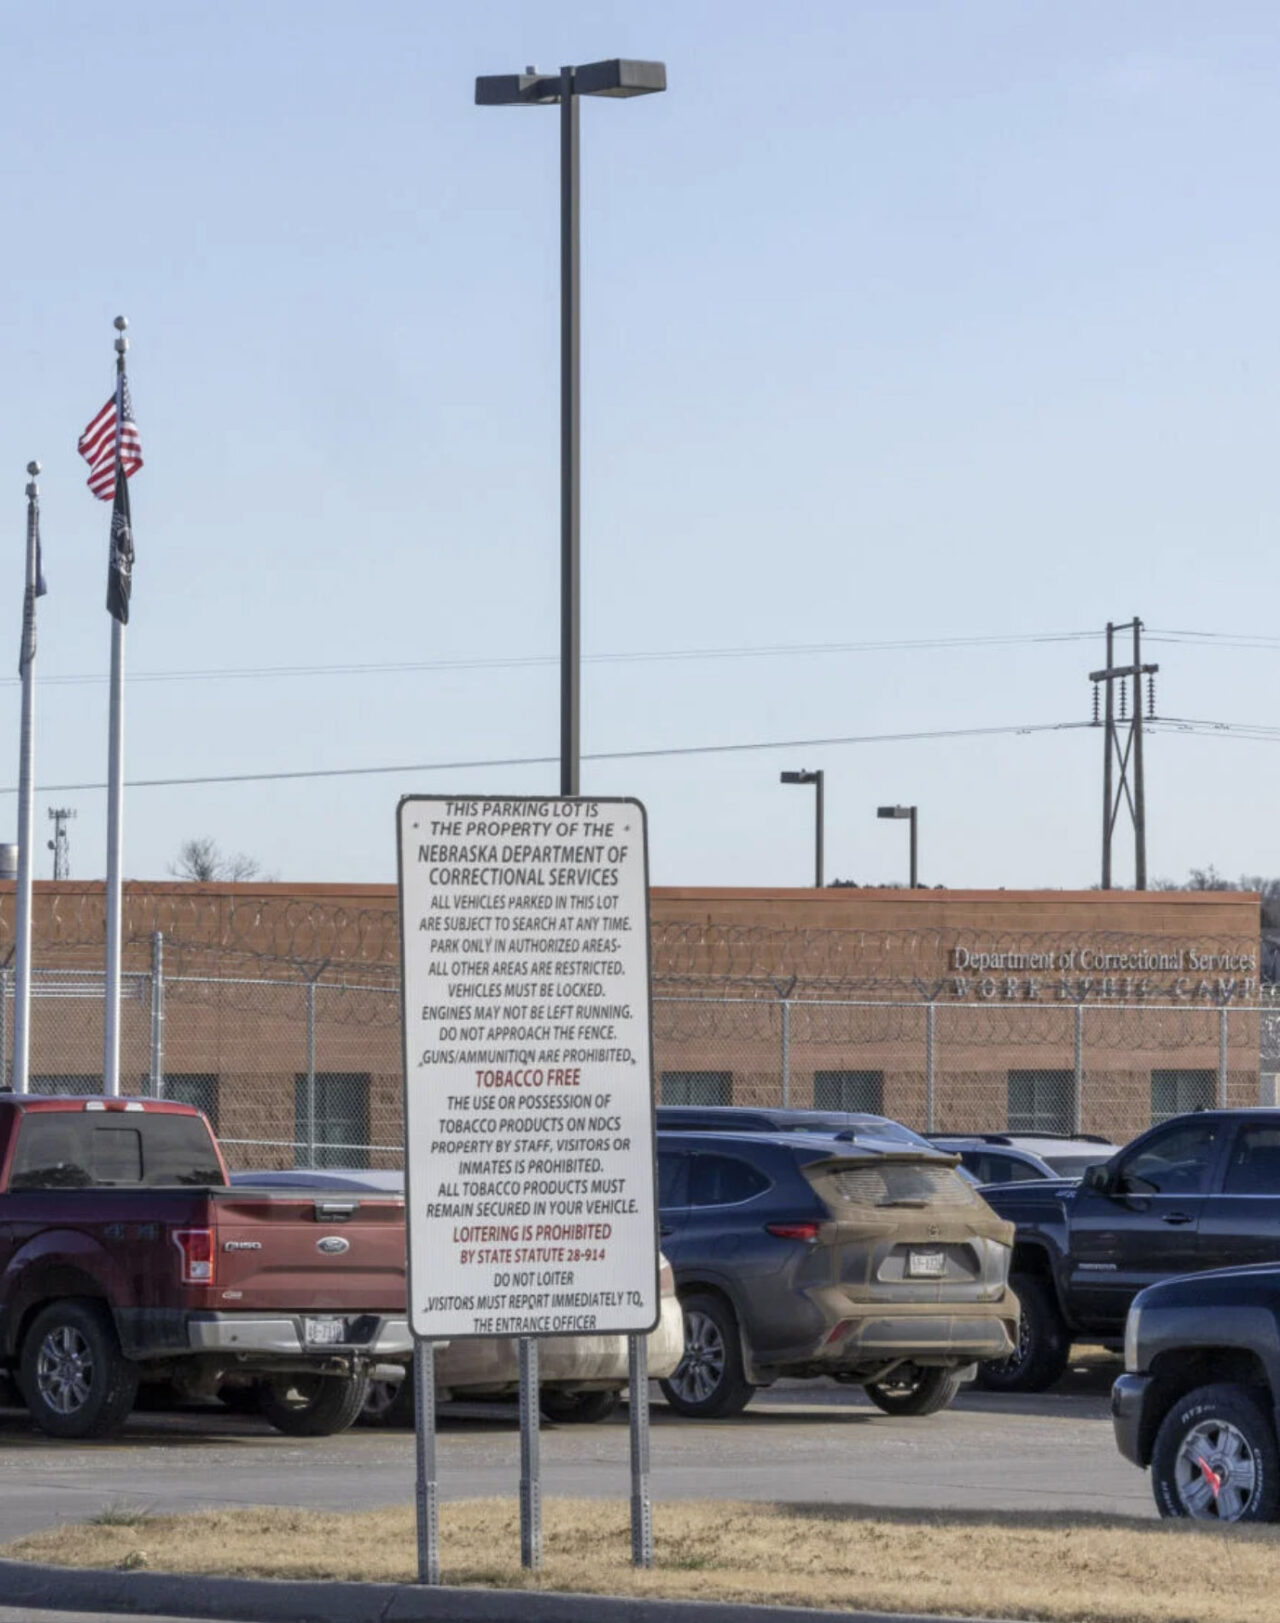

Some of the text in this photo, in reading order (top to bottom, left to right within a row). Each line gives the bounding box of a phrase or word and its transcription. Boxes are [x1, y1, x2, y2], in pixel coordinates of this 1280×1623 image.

[446, 802, 599, 817] THIS PARKING LOT IS
[431, 821, 614, 837] THE PROPERTY OF THE
[418, 845, 628, 863] NEBRASKA DEPARTMENT OF
[429, 868, 618, 886] CORRECTIONAL SERVICES
[431, 895, 619, 909] ALL VEHICLES PARKED IN THIS LOT
[419, 917, 632, 931] ARE SUBJECT TO SEARCH AT ANY TIME.
[431, 939, 459, 953] PARK
[462, 938, 492, 953] ONLY
[494, 939, 506, 952] IN
[508, 938, 580, 953] AUTHORIZED
[954, 946, 1256, 972] Department of Correctional Services
[428, 961, 625, 976] ALL OTHER AREAS ARE RESTRICTED.
[448, 983, 605, 997] VEHICLES MUST BE LOCKED.
[422, 1005, 632, 1020] ENGINES MAY NOT BE LEFT RUNNING.
[439, 1025, 616, 1041] DO NOT APPROACH THE FENCE.
[422, 1050, 536, 1064] GUNS/AMMUNITION
[538, 1049, 560, 1063] ARE
[476, 1068, 580, 1087] TOBACCO FREE
[448, 1094, 611, 1110] THE USE OR POSSESSION OF
[440, 1117, 621, 1133] TOBACCO PRODUCTS ON NDCS
[431, 1138, 630, 1153] PROPERTY BY STAFF, VISITORS OR
[459, 1158, 603, 1174] INMATES IS PROHIBITED.
[438, 1179, 626, 1197] ALL TOBACCO PRODUCTS MUST
[426, 1199, 638, 1218] REMAIN SECURED IN YOUR VEHICLE.
[453, 1223, 612, 1242] LOITERING IS PROHIBITED
[460, 1248, 605, 1264] BY STATE STATUTE 28-914
[494, 1271, 574, 1287] DO NOT LOITER
[428, 1291, 641, 1311] VISITORS MUST REPORT IMMEDIATELY TO
[474, 1315, 596, 1332] THE ENTRANCE OFFICER
